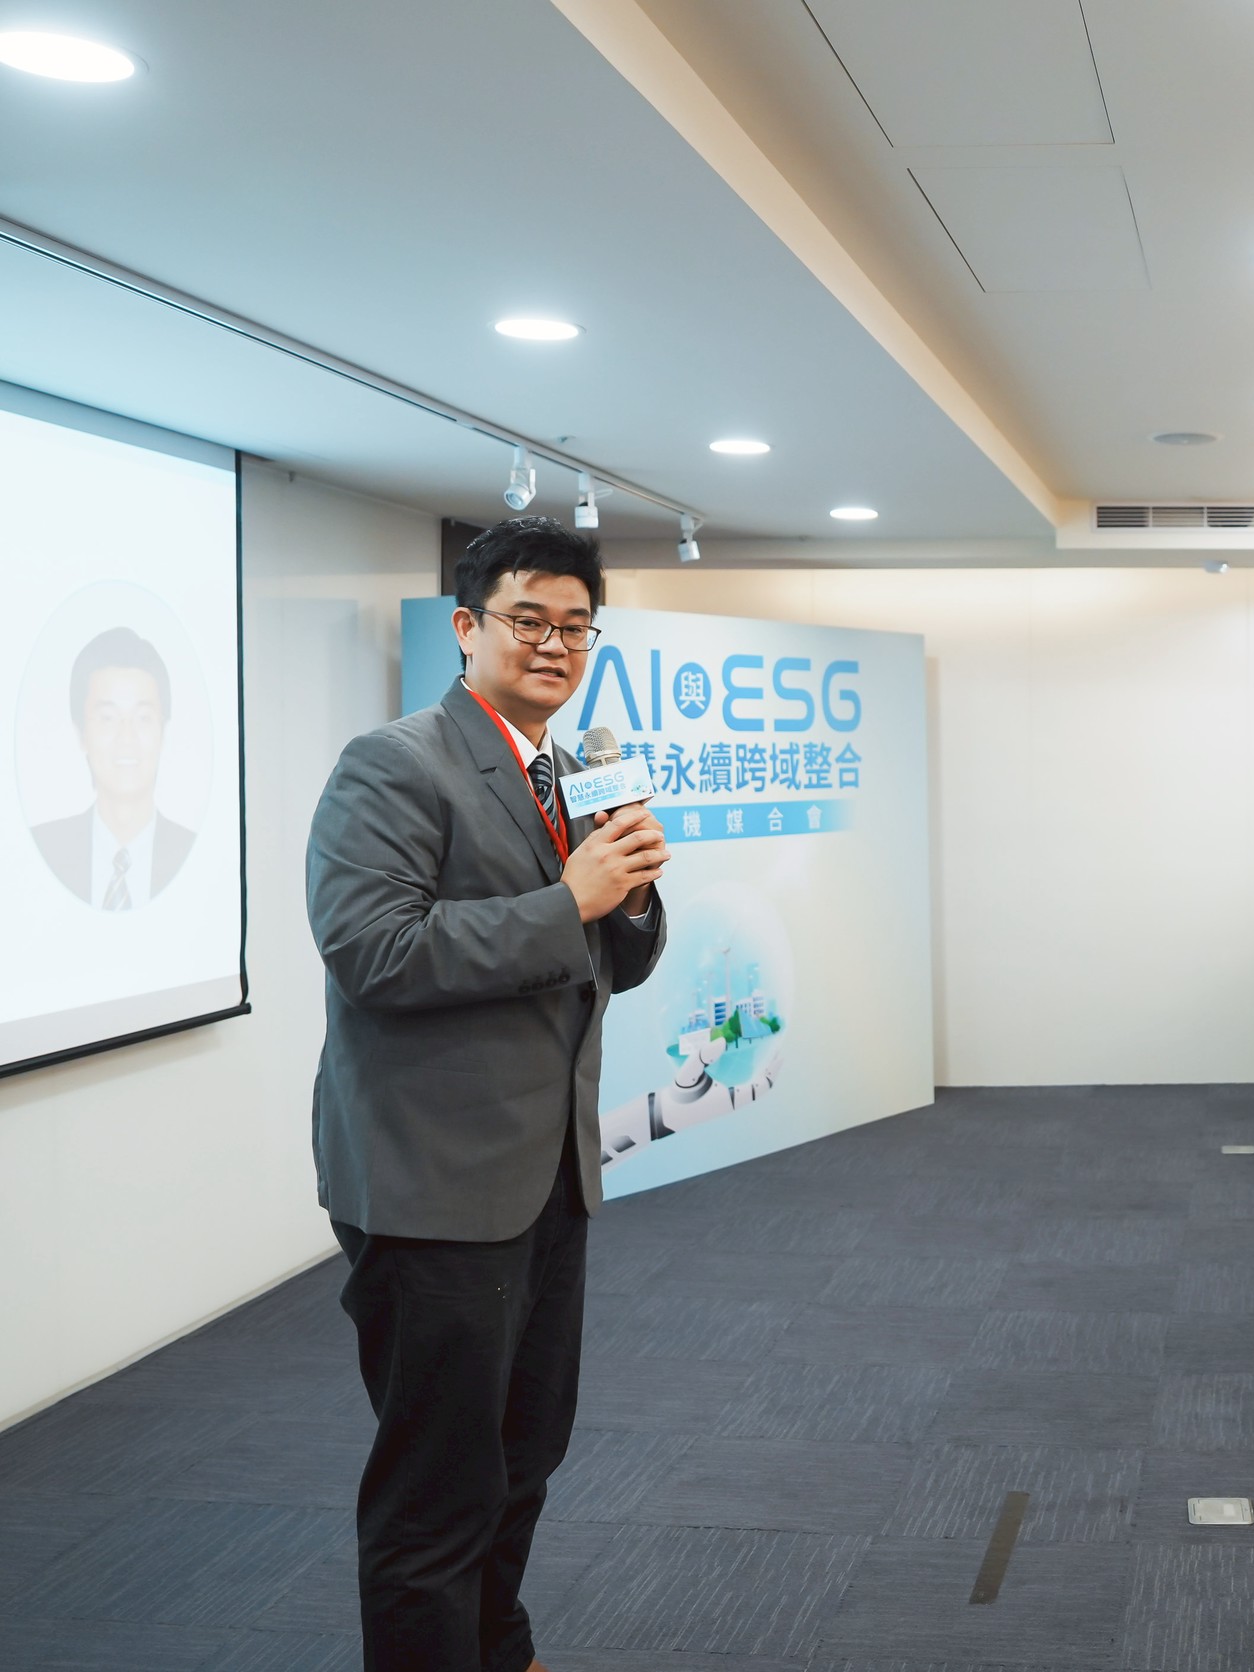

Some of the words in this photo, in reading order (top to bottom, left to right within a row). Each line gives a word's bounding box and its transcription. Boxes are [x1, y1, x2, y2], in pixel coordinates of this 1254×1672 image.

[576, 741, 862, 795] 永續跨域整合
